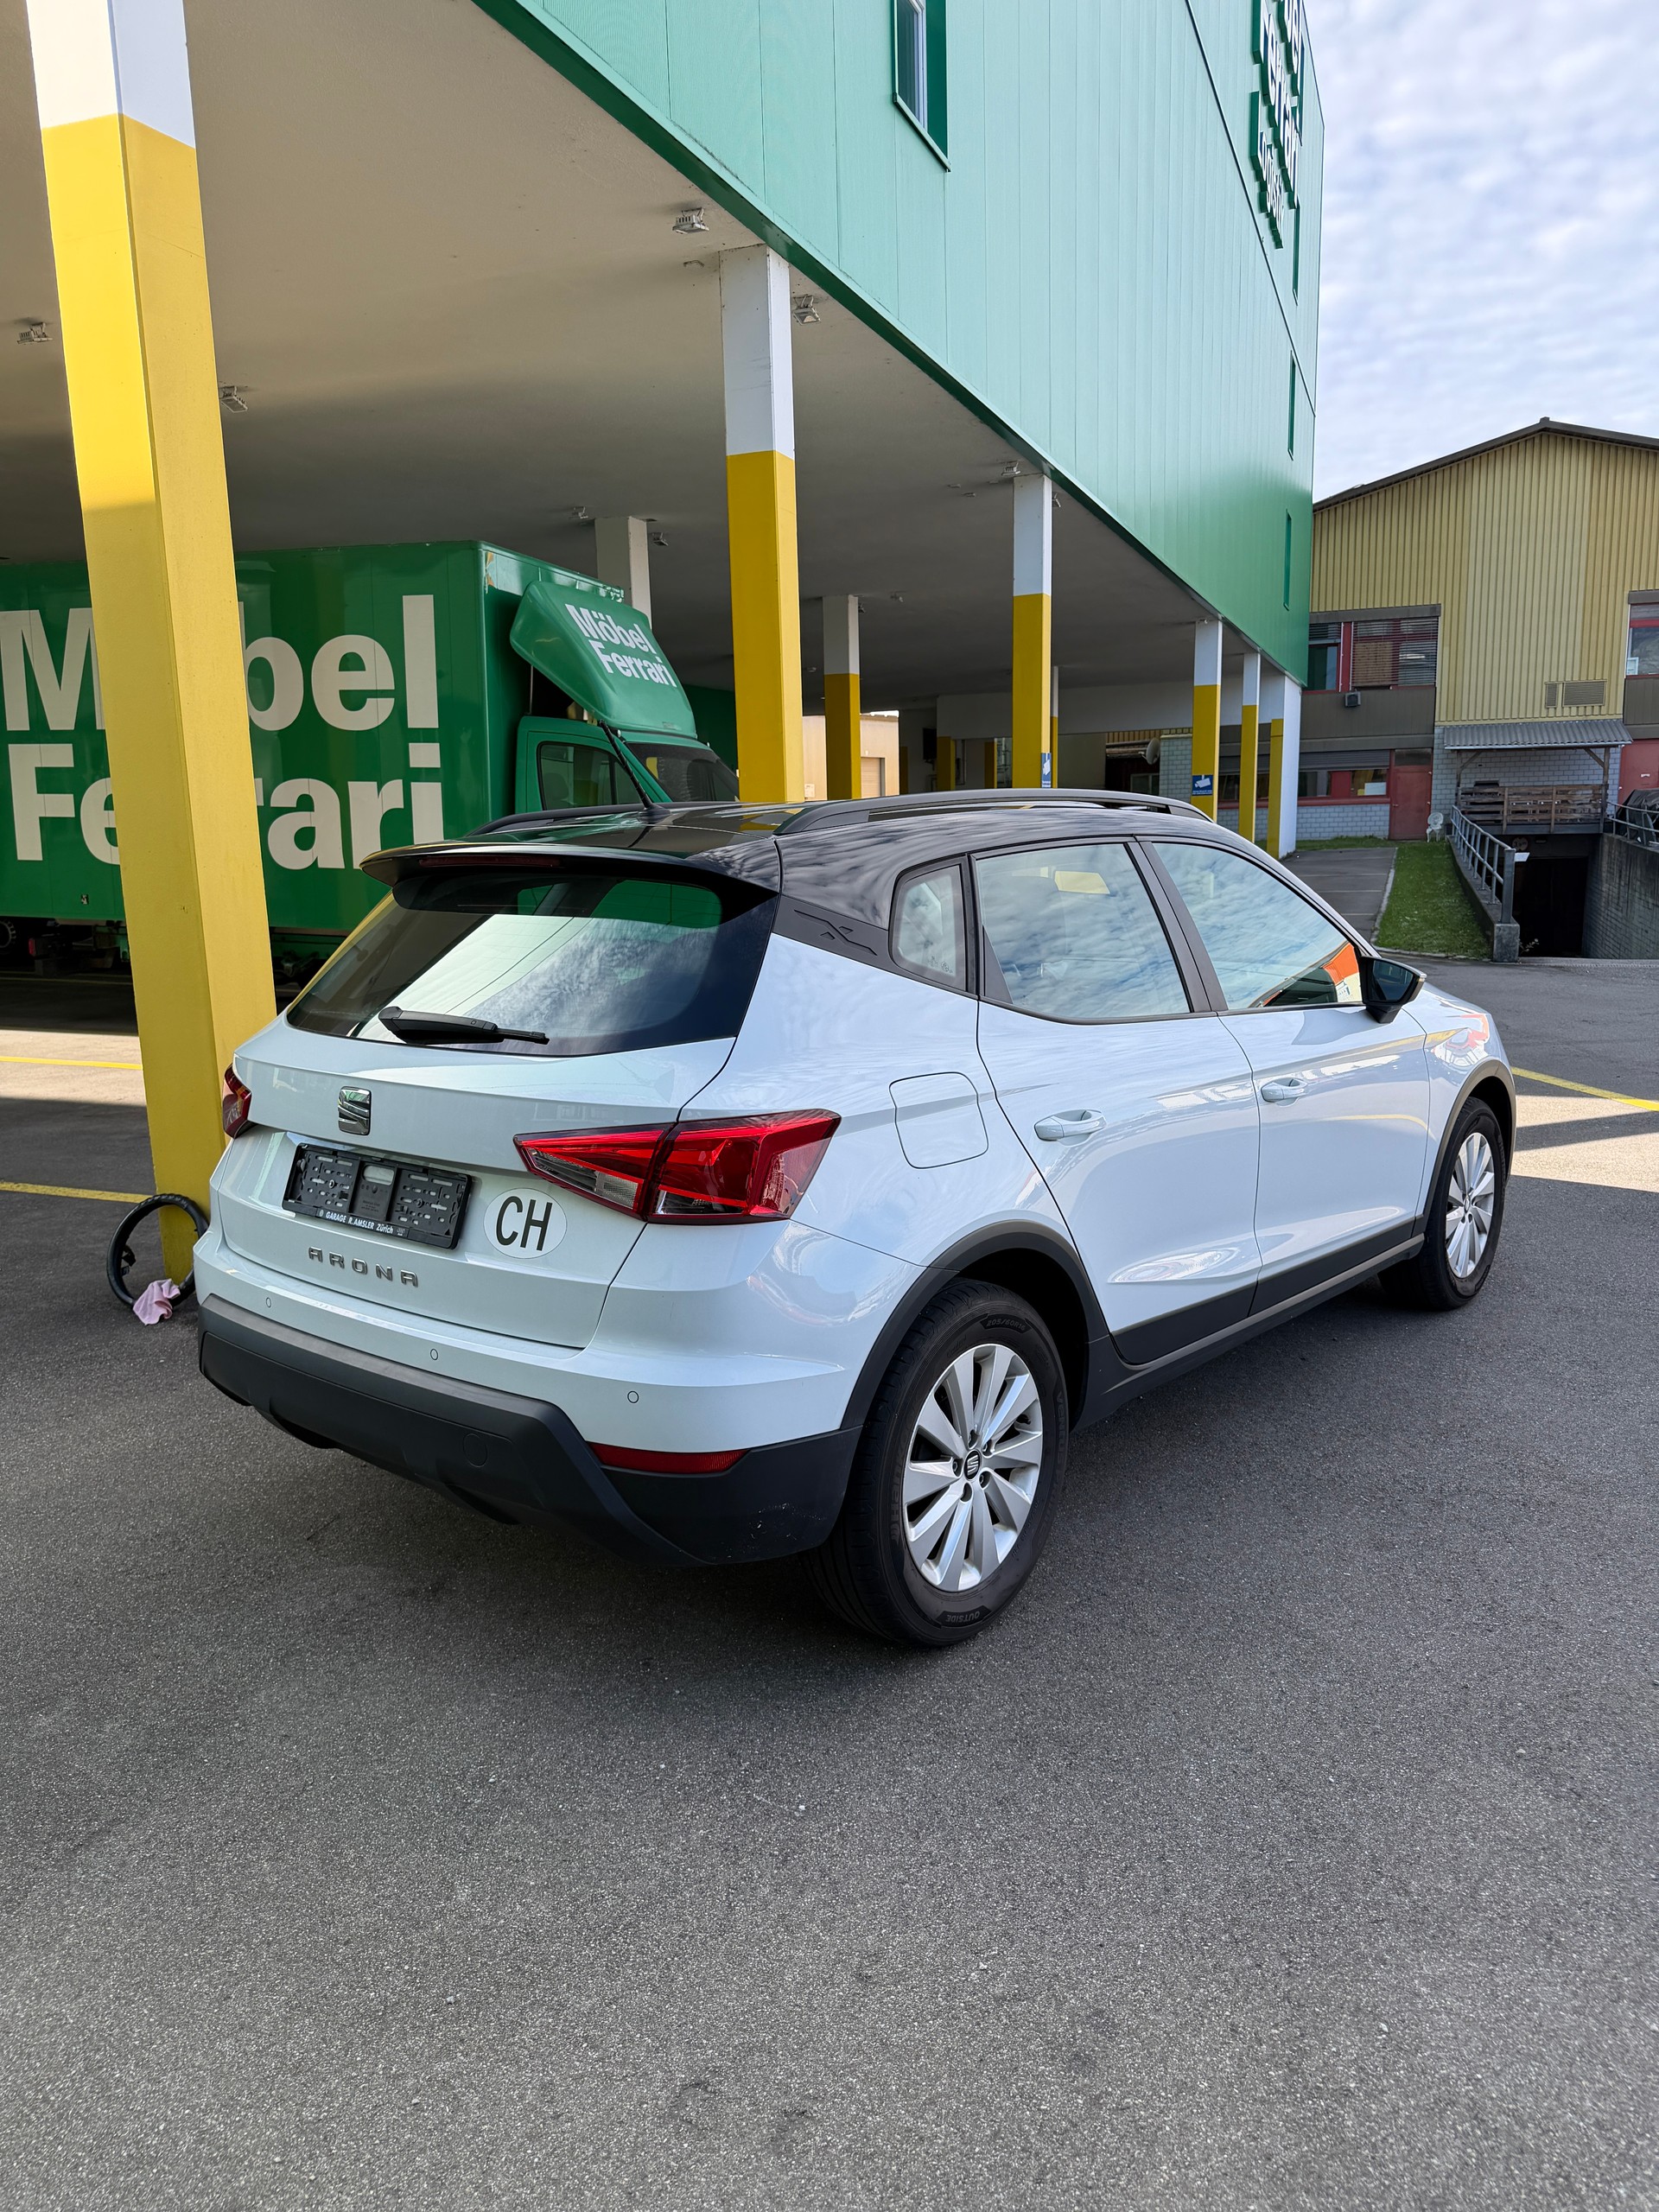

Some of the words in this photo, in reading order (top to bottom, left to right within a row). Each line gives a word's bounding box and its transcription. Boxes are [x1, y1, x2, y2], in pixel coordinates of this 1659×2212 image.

[564, 603, 657, 654] Möbel
[0, 594, 439, 731] Mbel
[588, 639, 677, 688] Ferrari
[325, 1211, 347, 1224] GARAGE
[375, 1223, 394, 1234] Zürich
[495, 1195, 553, 1252] CH
[308, 1246, 419, 1287] ARONA
[944, 1610, 981, 1623] OUTSIDE
